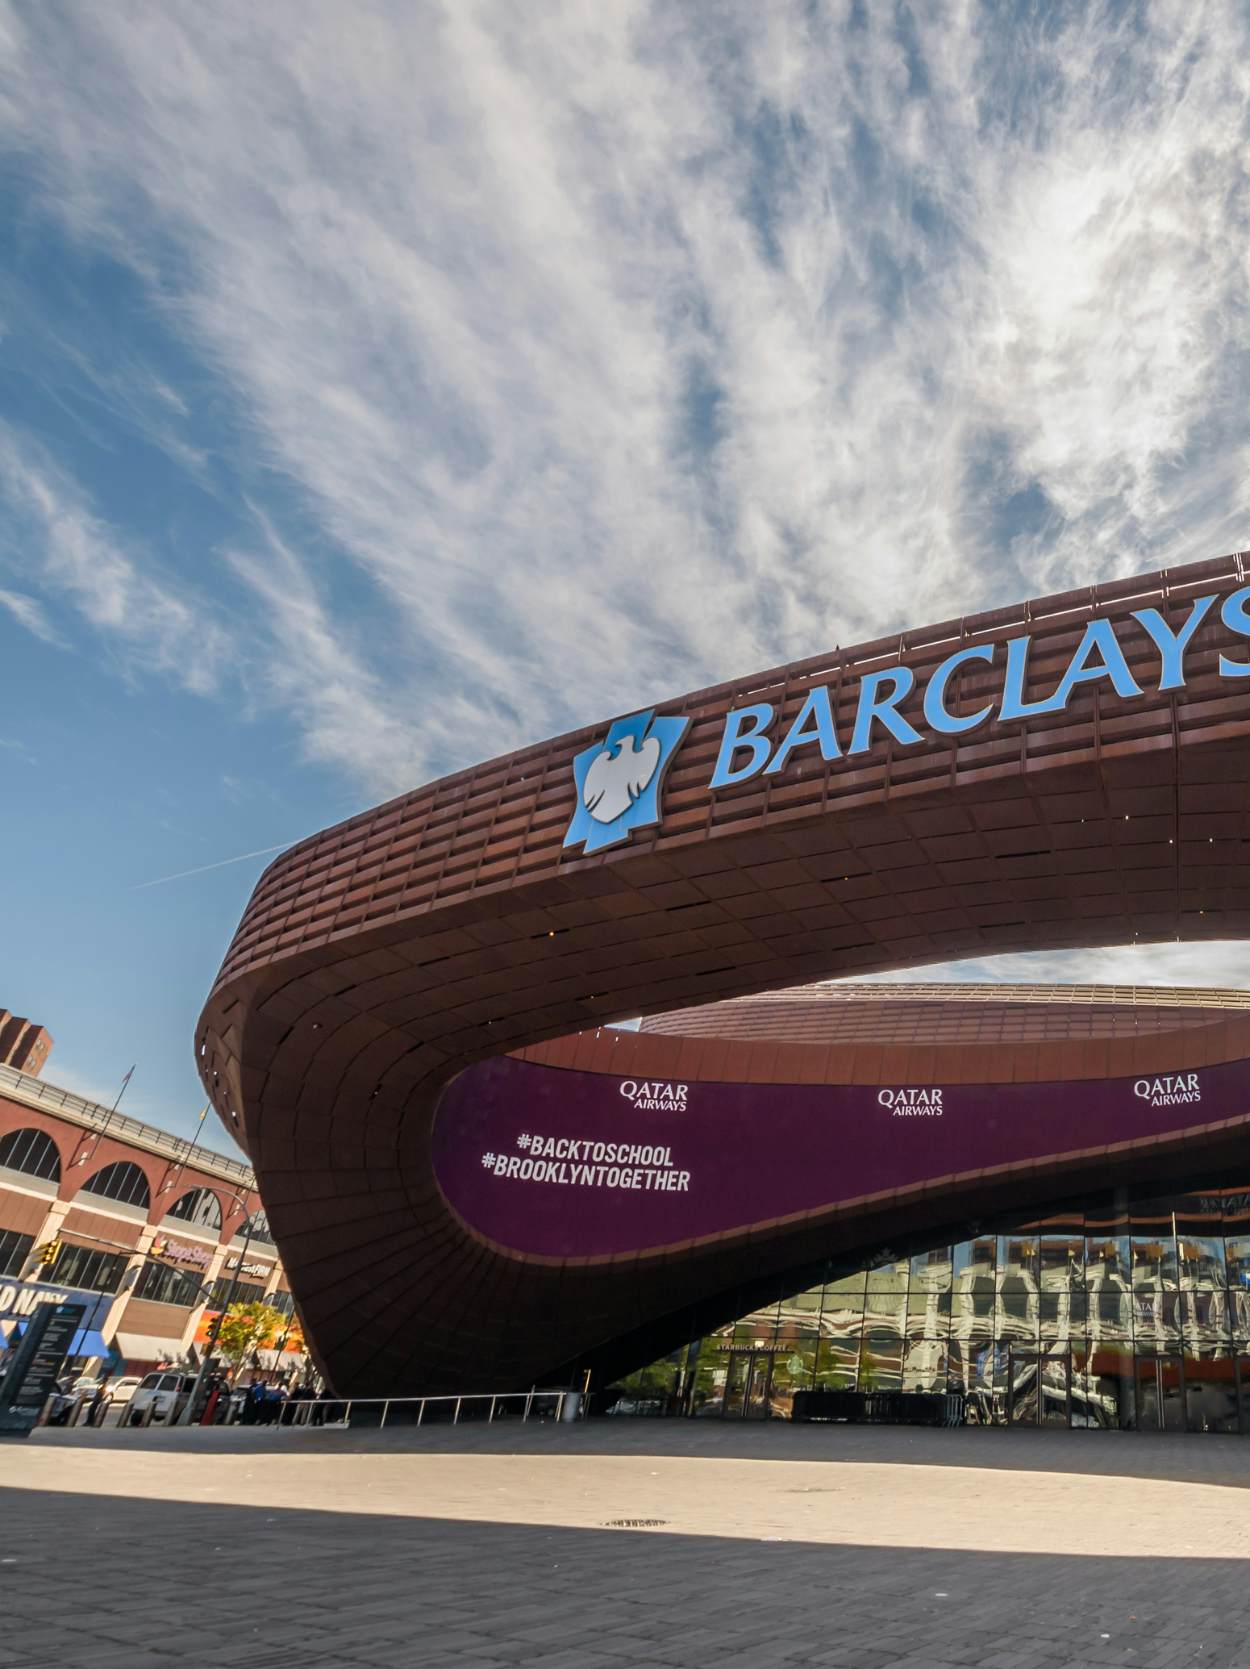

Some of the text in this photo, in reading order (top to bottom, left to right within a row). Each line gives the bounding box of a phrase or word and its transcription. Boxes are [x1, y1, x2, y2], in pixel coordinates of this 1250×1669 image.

[619, 1080, 689, 1101] QATAR
[1133, 1073, 1201, 1100] QATAR
[633, 1099, 687, 1112] AIRWAYS
[877, 1088, 944, 1109] QATAR
[1151, 1090, 1201, 1107] AIRWAYS
[892, 1105, 943, 1116] AIRWAYS
[516, 1132, 675, 1167] #BACKTOSCHOOL
[480, 1151, 691, 1192] #BROOKLYNTOGETHER
